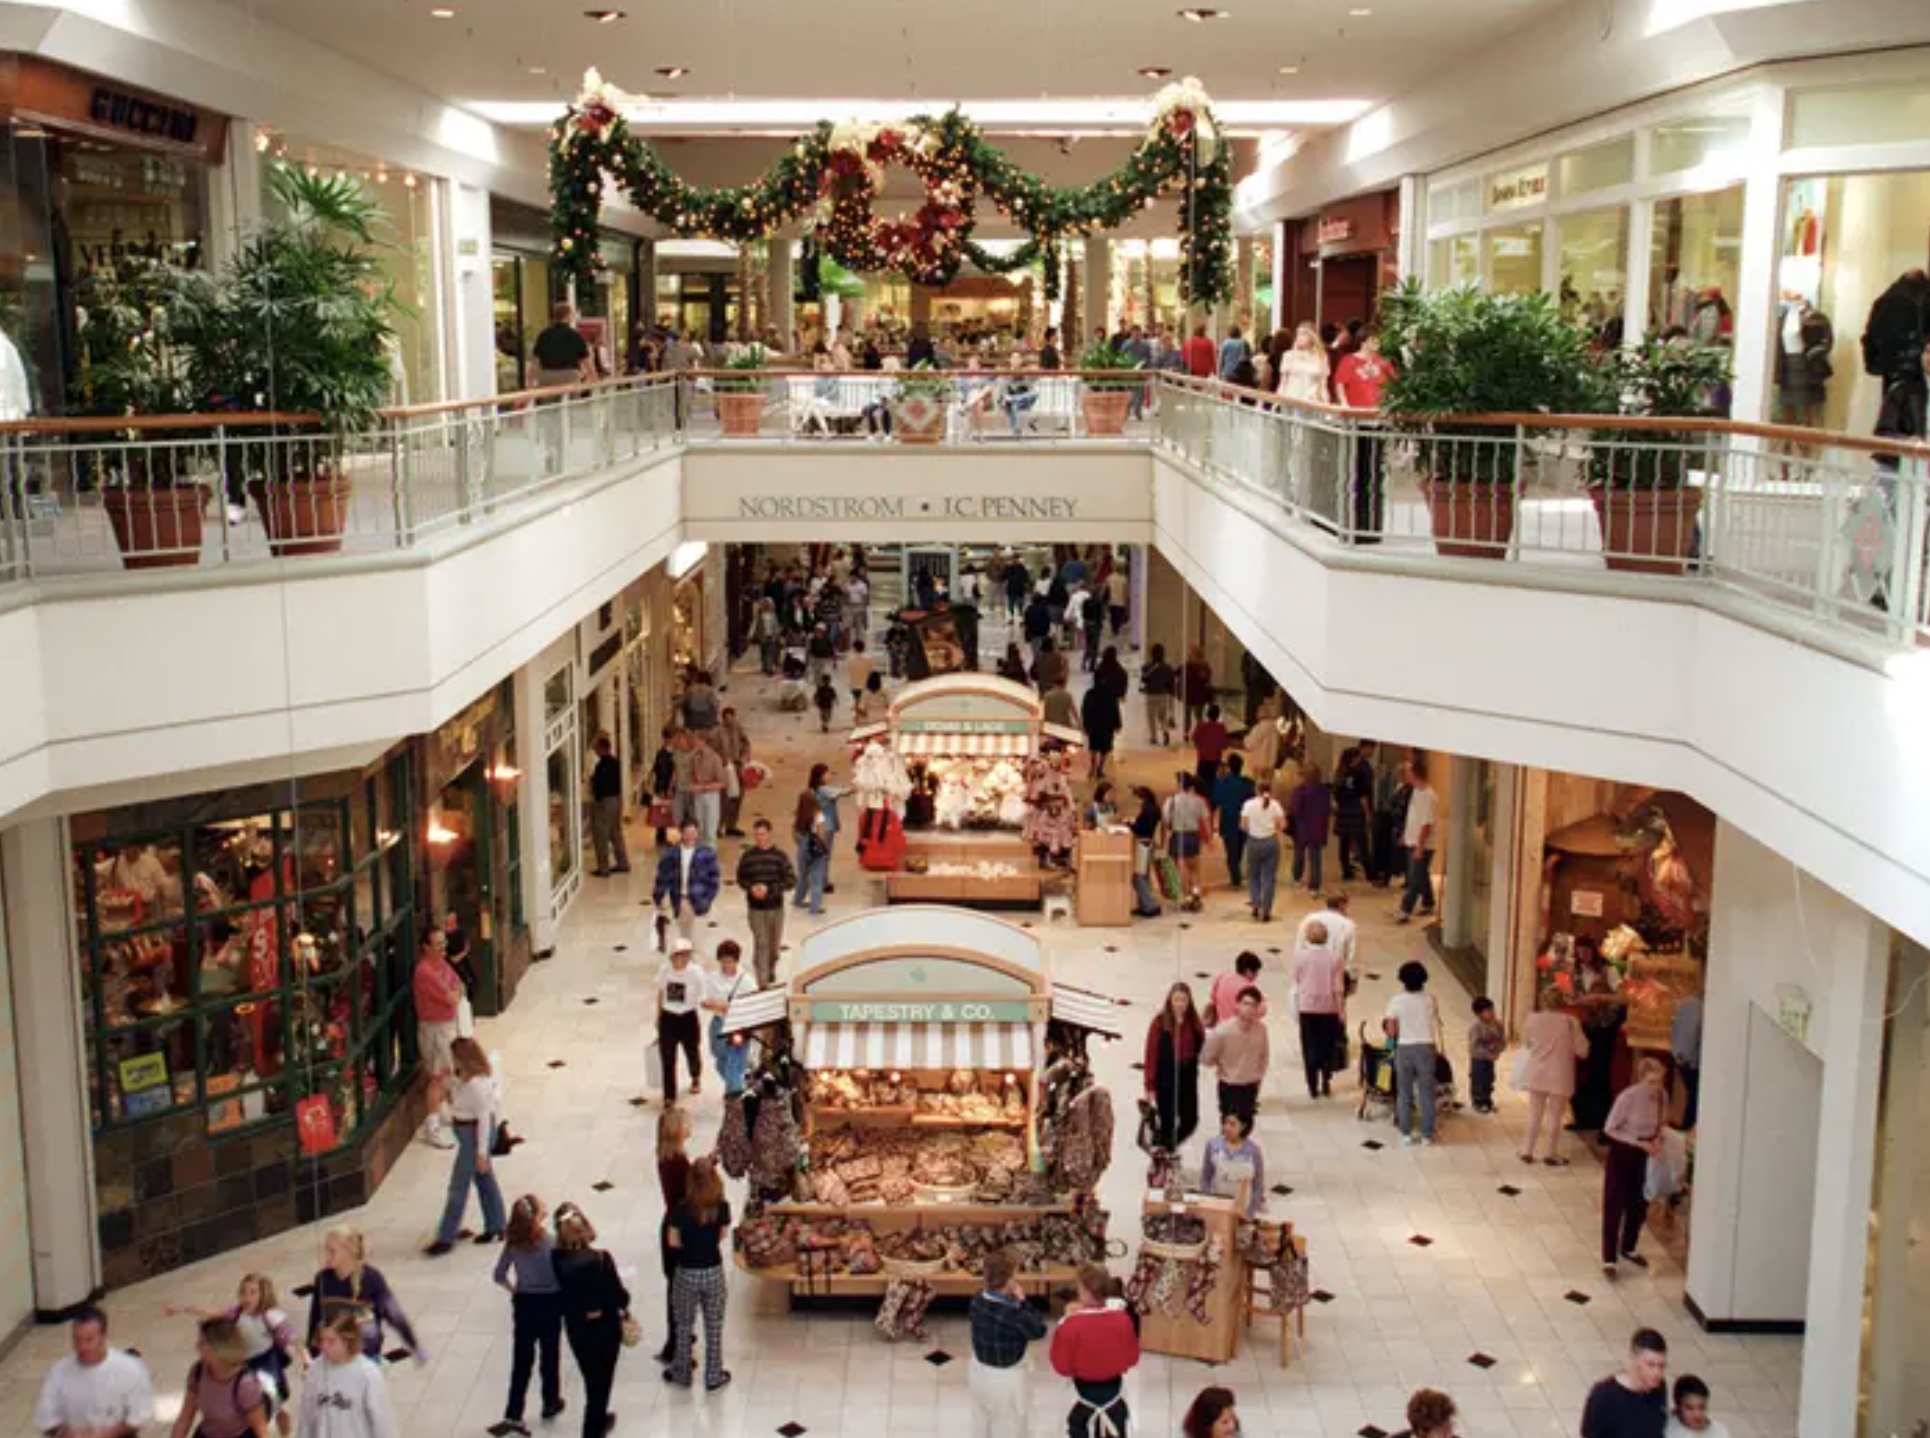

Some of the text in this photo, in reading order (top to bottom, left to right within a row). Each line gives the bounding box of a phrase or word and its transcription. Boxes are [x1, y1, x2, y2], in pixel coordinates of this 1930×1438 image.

[740, 496, 905, 518] NORDSTROM
[981, 496, 1080, 518] PENNEY
[839, 1002, 996, 1020] TAPESTRY & CO.
